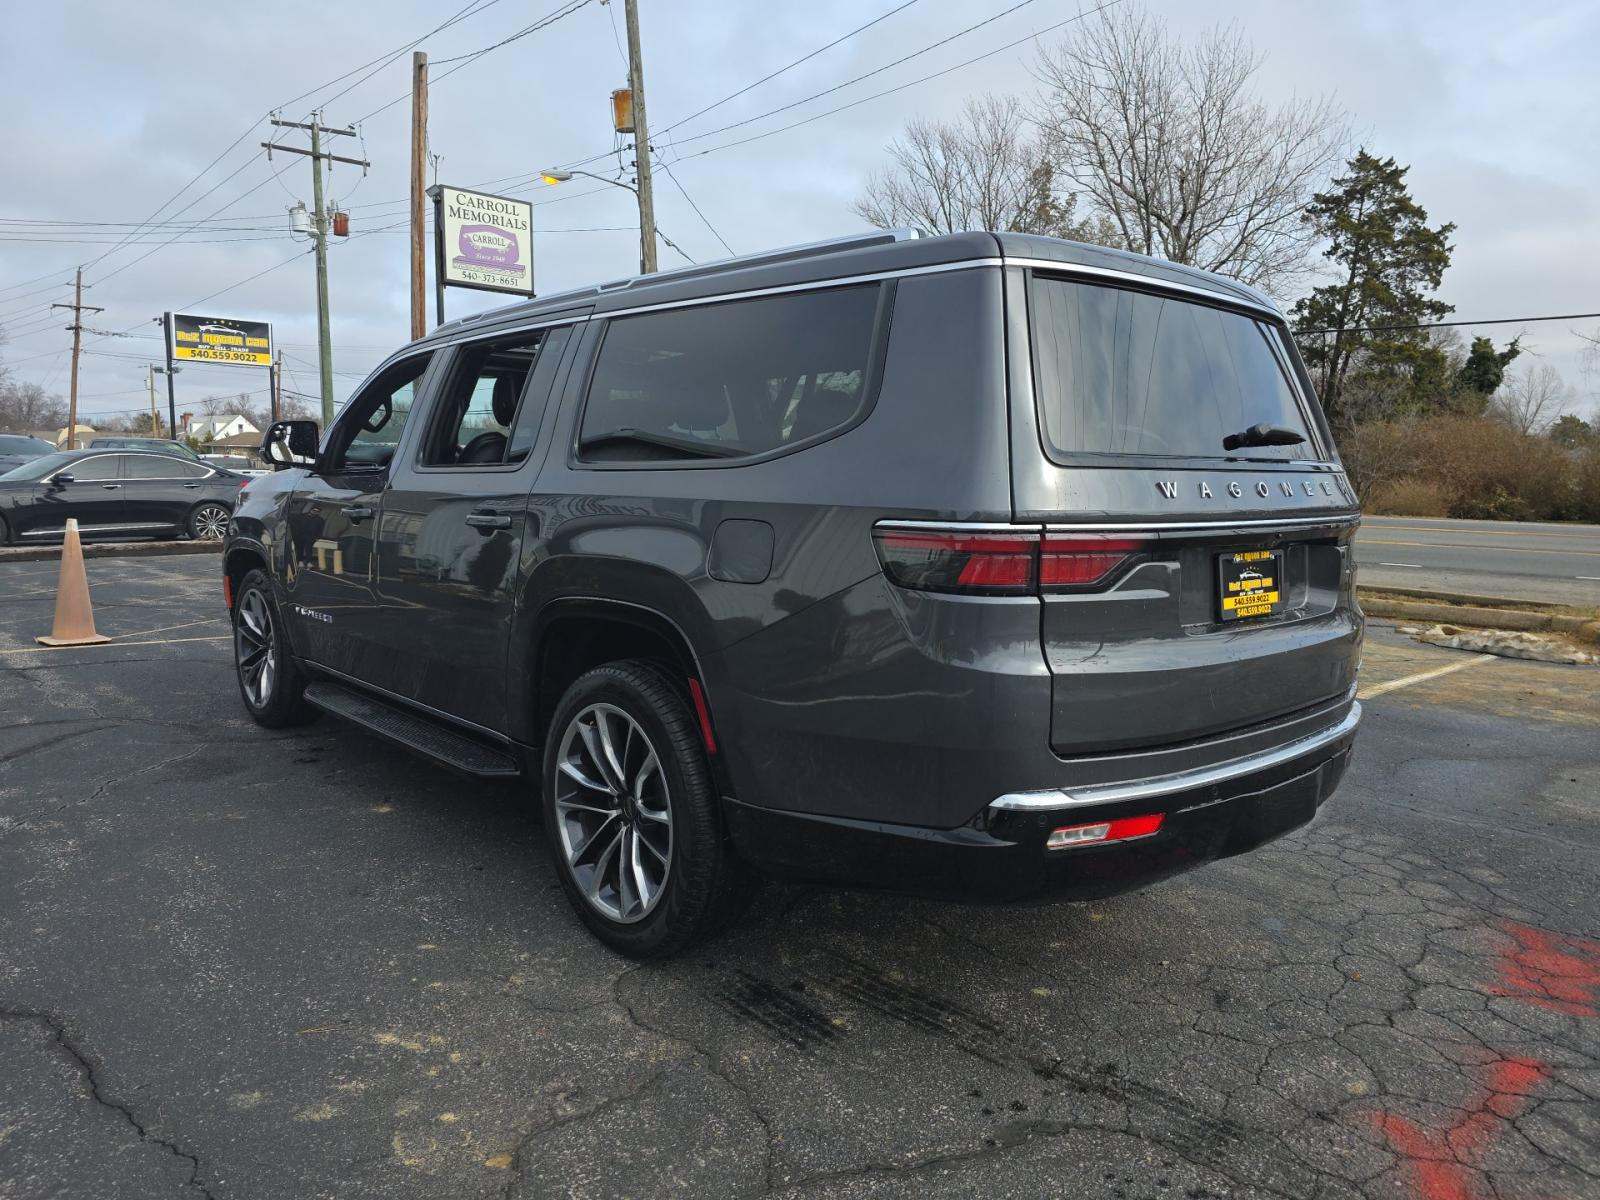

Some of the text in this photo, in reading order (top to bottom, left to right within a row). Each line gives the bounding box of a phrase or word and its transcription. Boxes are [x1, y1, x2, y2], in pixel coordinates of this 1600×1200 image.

[456, 193, 519, 216] CARROLL
[449, 205, 527, 230] MEMORIALS
[472, 234, 506, 247] CARROLL
[462, 271, 518, 286] 540-373-8651
[190, 349, 257, 362] 540.559.9022
[1233, 595, 1269, 606] 540.559.9022
[1237, 604, 1271, 617] 540.559.9022
